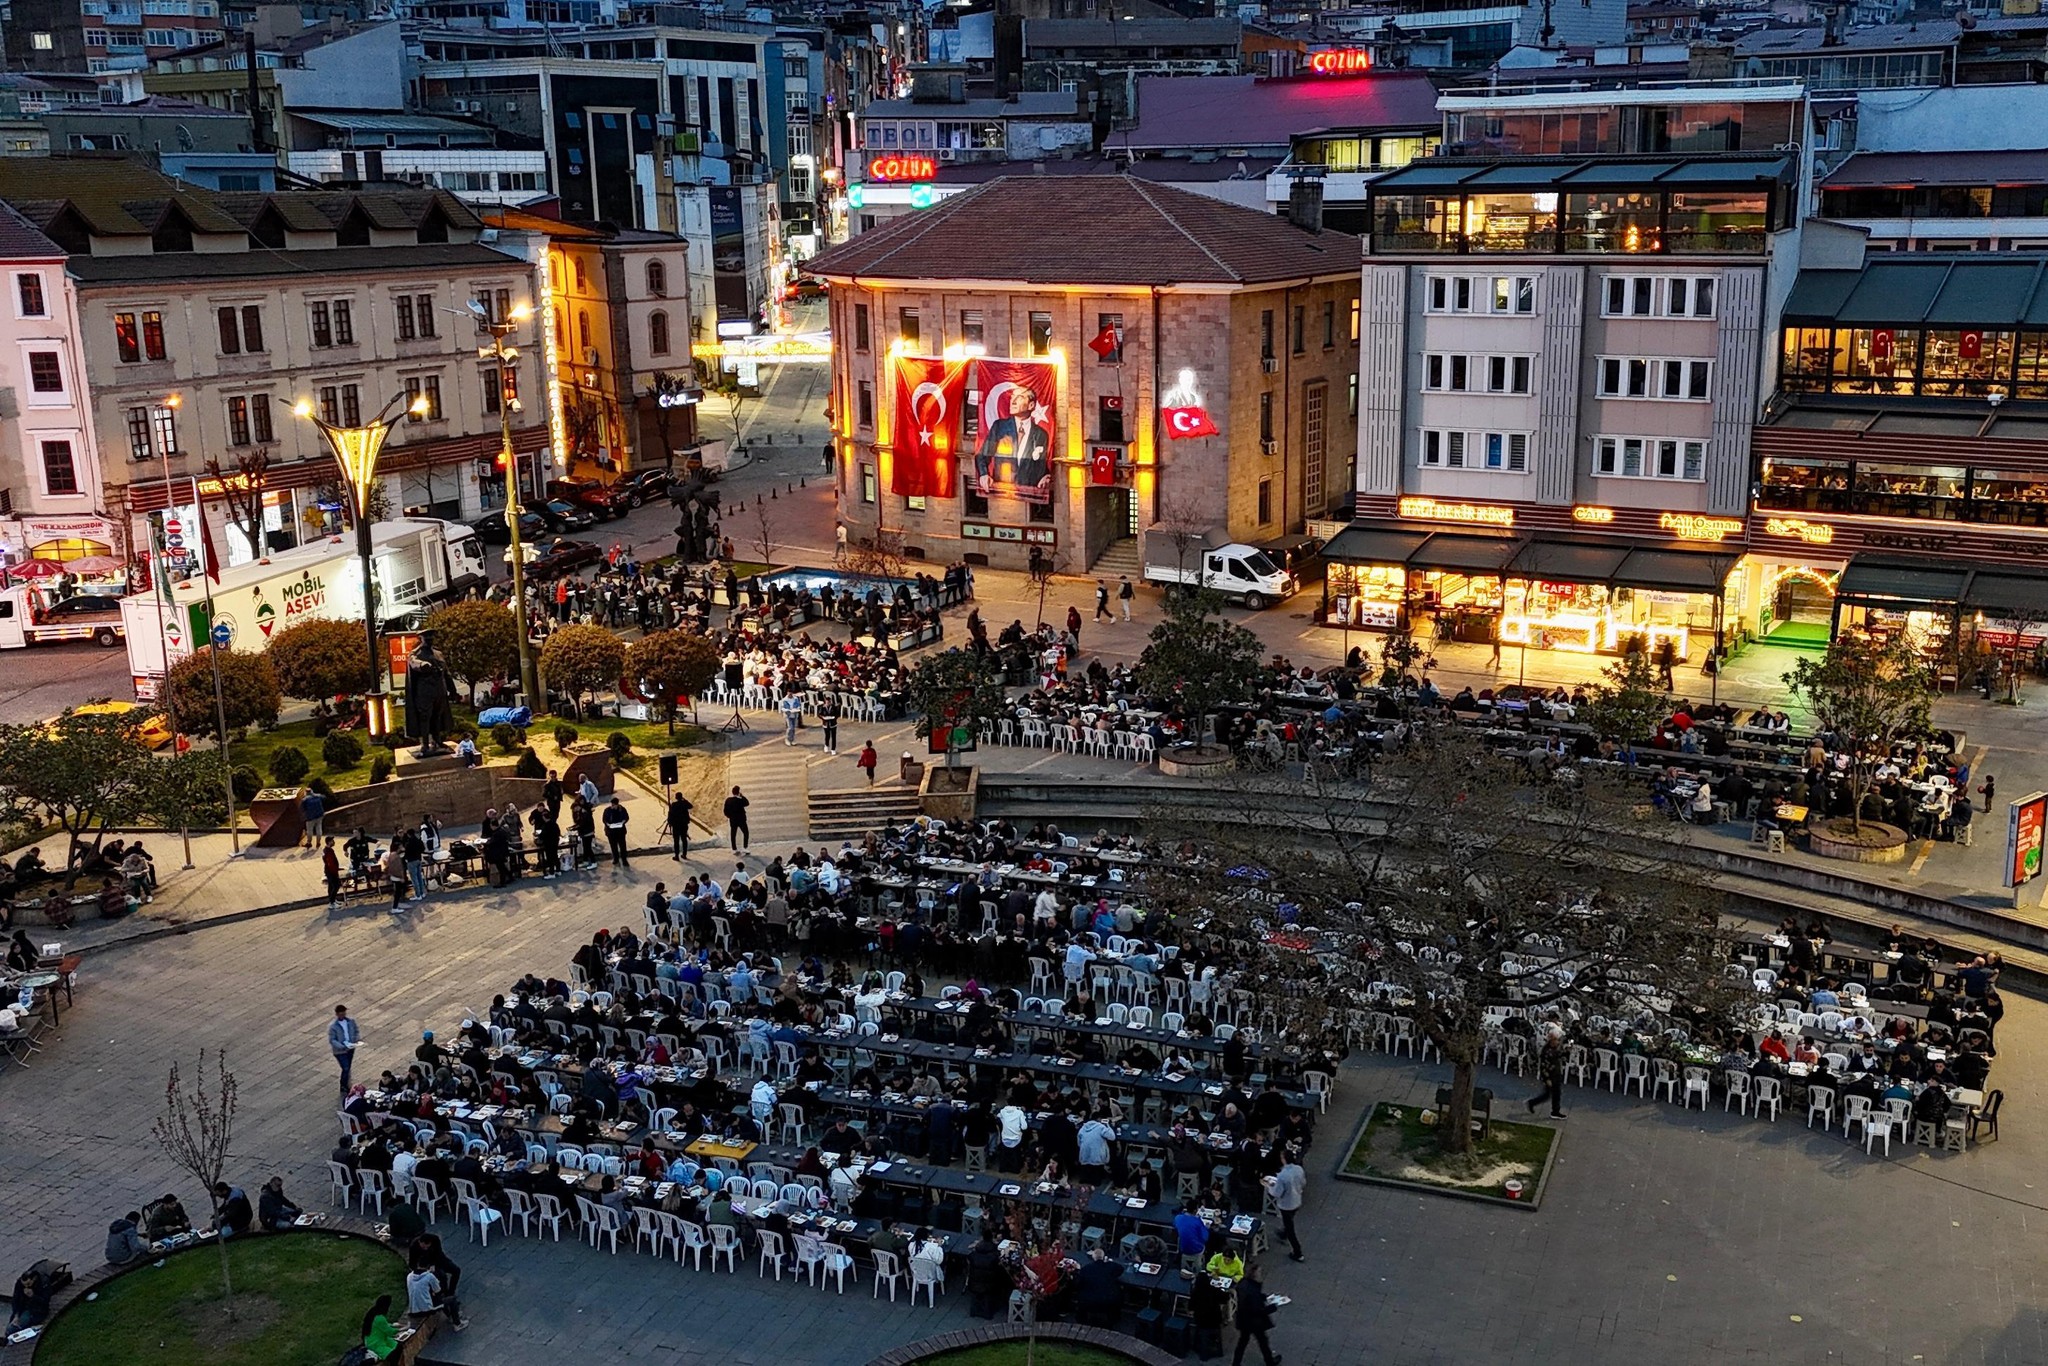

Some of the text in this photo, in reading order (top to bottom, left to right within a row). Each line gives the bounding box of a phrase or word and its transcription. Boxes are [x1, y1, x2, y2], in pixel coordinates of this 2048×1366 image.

[867, 127, 933, 143] TEOL
[1575, 508, 1611, 521] CAFE
[1694, 517, 1742, 531] Osman
[1678, 527, 1723, 540] Ulusoy
[1543, 584, 1572, 594] CAFE
